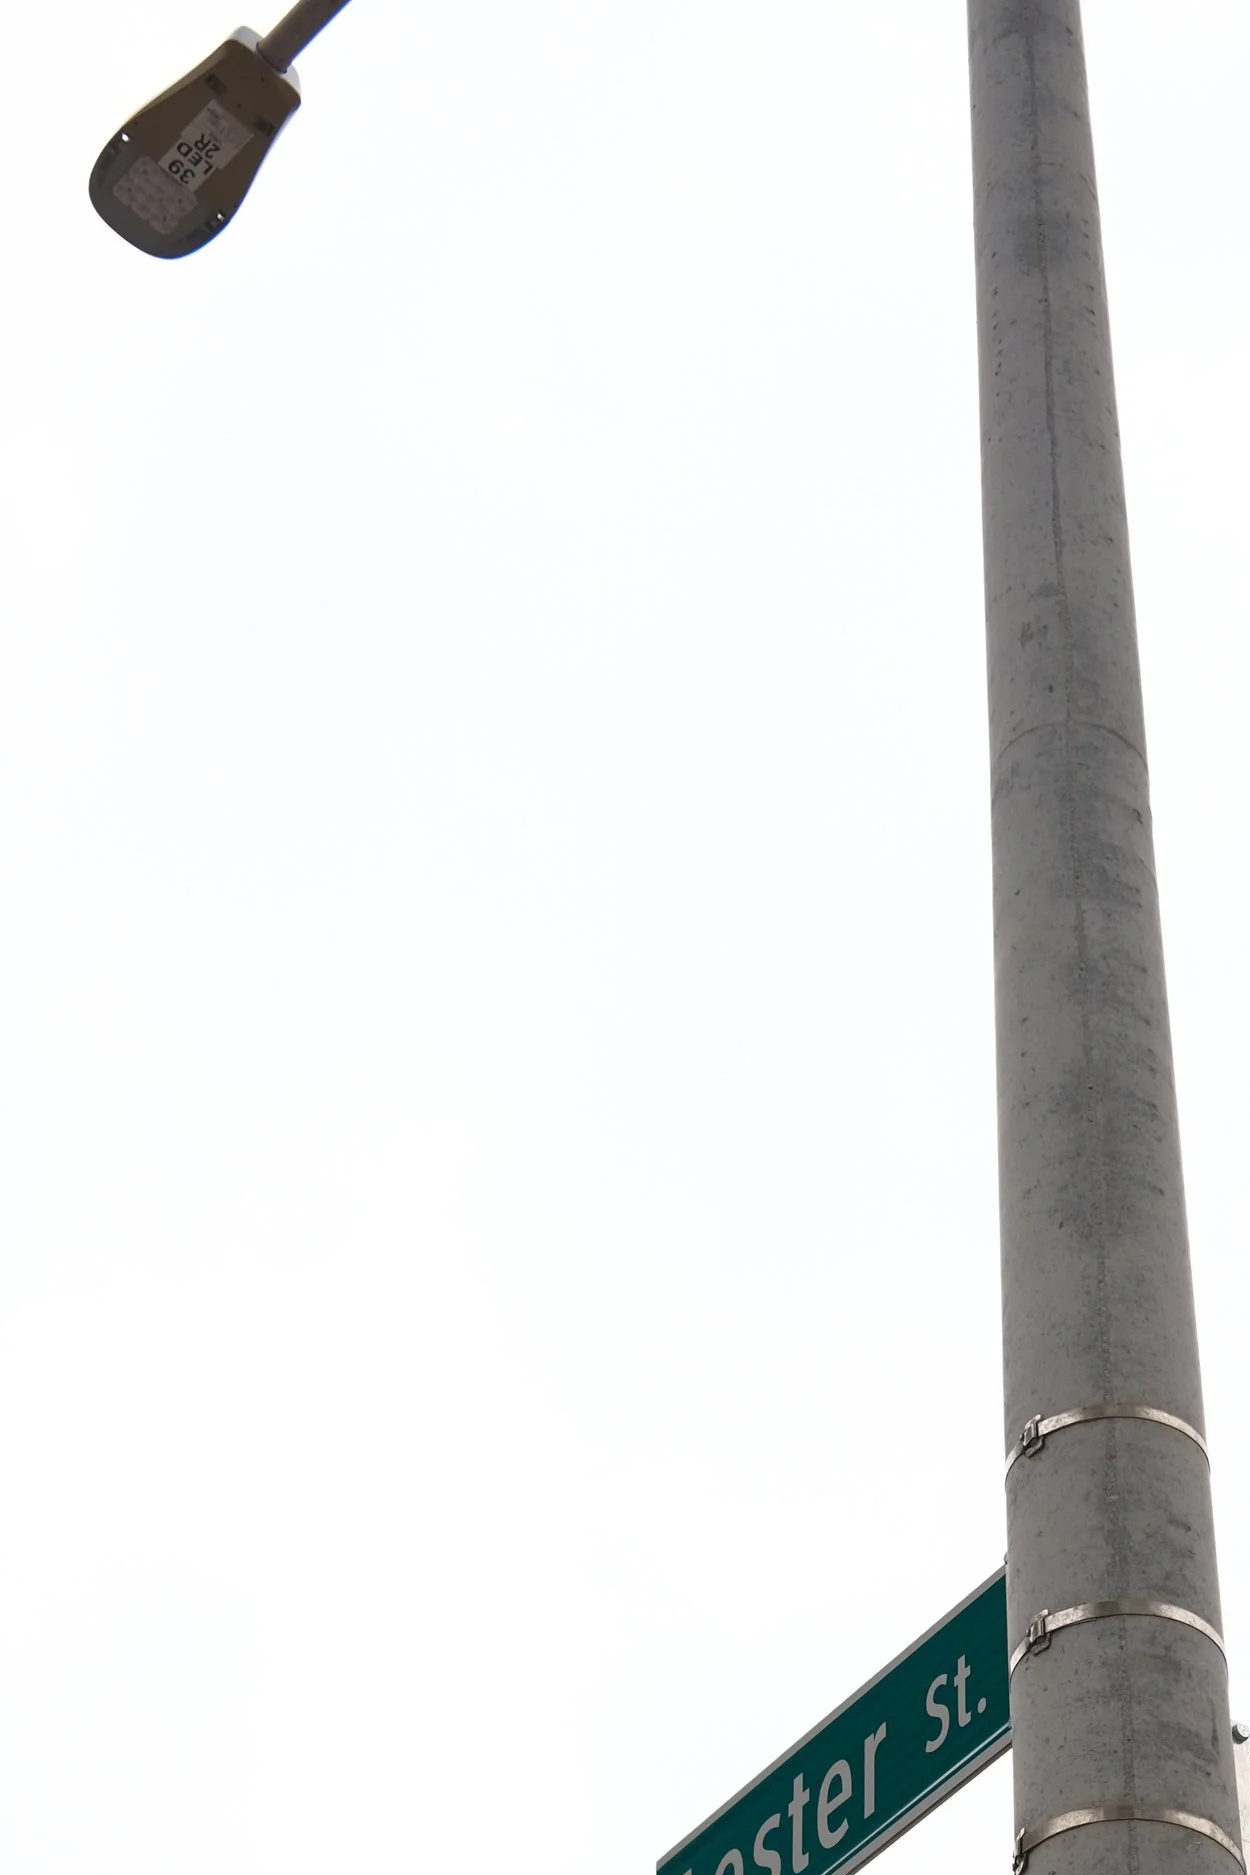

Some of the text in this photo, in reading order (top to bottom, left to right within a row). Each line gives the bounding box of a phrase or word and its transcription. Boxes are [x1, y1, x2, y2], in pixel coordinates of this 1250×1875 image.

[177, 142, 213, 175] LED
[194, 133, 221, 159] 2R
[168, 159, 196, 184] 39
[925, 1654, 987, 1753] St.
